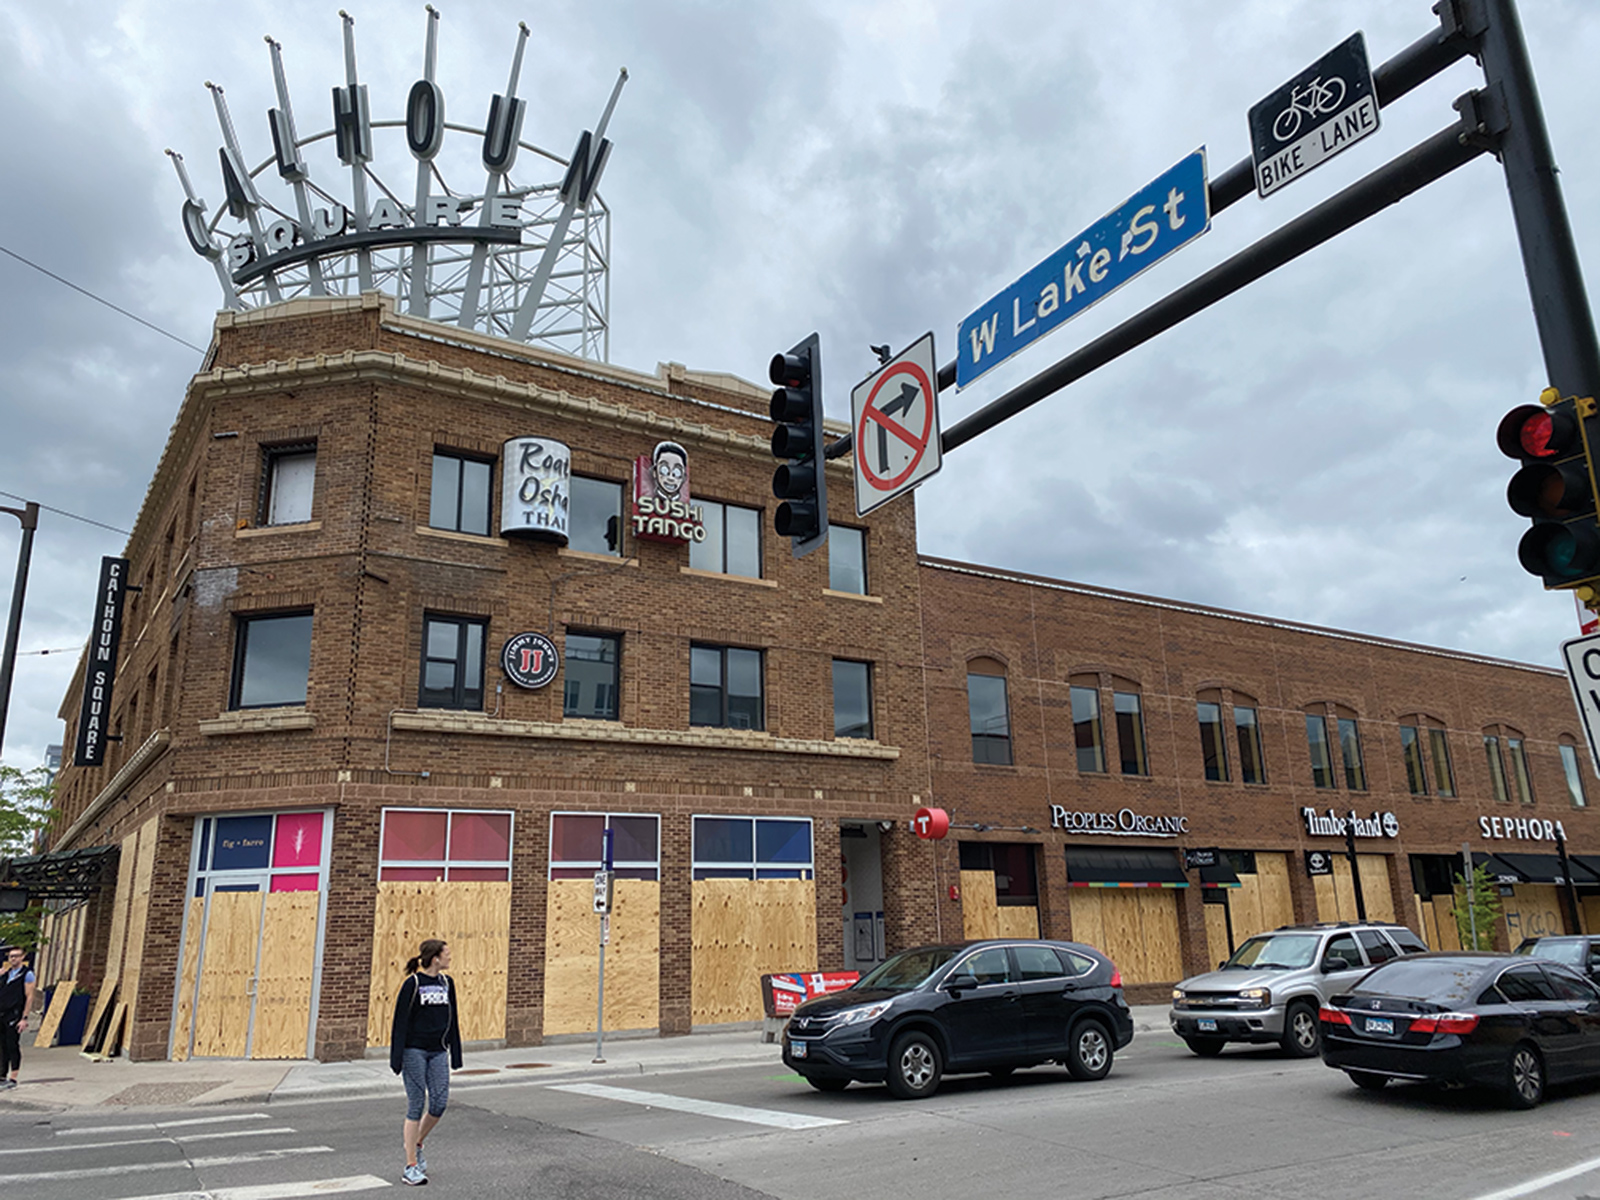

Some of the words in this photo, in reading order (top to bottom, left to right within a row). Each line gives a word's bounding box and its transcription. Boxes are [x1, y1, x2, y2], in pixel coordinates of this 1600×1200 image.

[182, 79, 614, 262] CALHOUN
[1260, 146, 1305, 190] BIKE
[1320, 102, 1374, 153] LANE
[228, 195, 524, 270] SQUARE
[969, 312, 998, 363] W
[1013, 247, 1111, 337] Lake
[1130, 187, 1186, 255] St
[632, 515, 707, 542] TANGO
[638, 495, 704, 523] SUSHI
[97, 563, 121, 661] CALHOUN
[508, 637, 530, 660] JIMMY
[520, 648, 544, 674] JJ
[85, 671, 106, 759] SQUARE
[1480, 816, 1568, 840] SEPHORA
